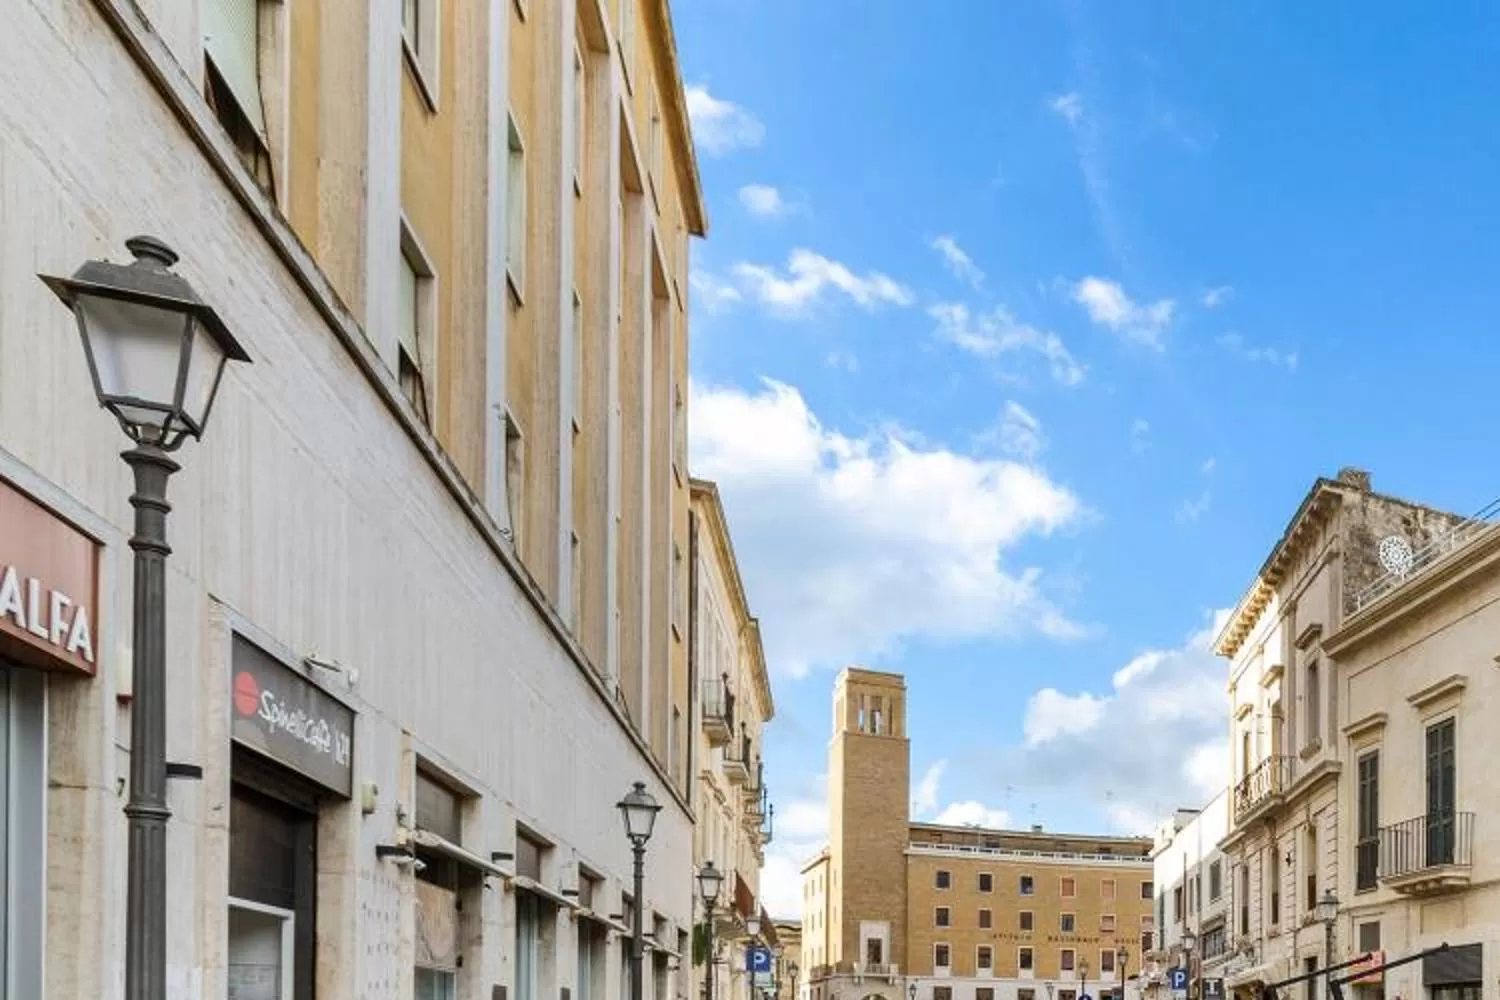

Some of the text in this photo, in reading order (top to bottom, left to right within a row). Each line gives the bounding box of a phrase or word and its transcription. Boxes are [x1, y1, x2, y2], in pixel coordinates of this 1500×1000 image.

[0, 566, 94, 663] ALFA
[753, 951, 767, 969] P
[1175, 971, 1185, 987] P
